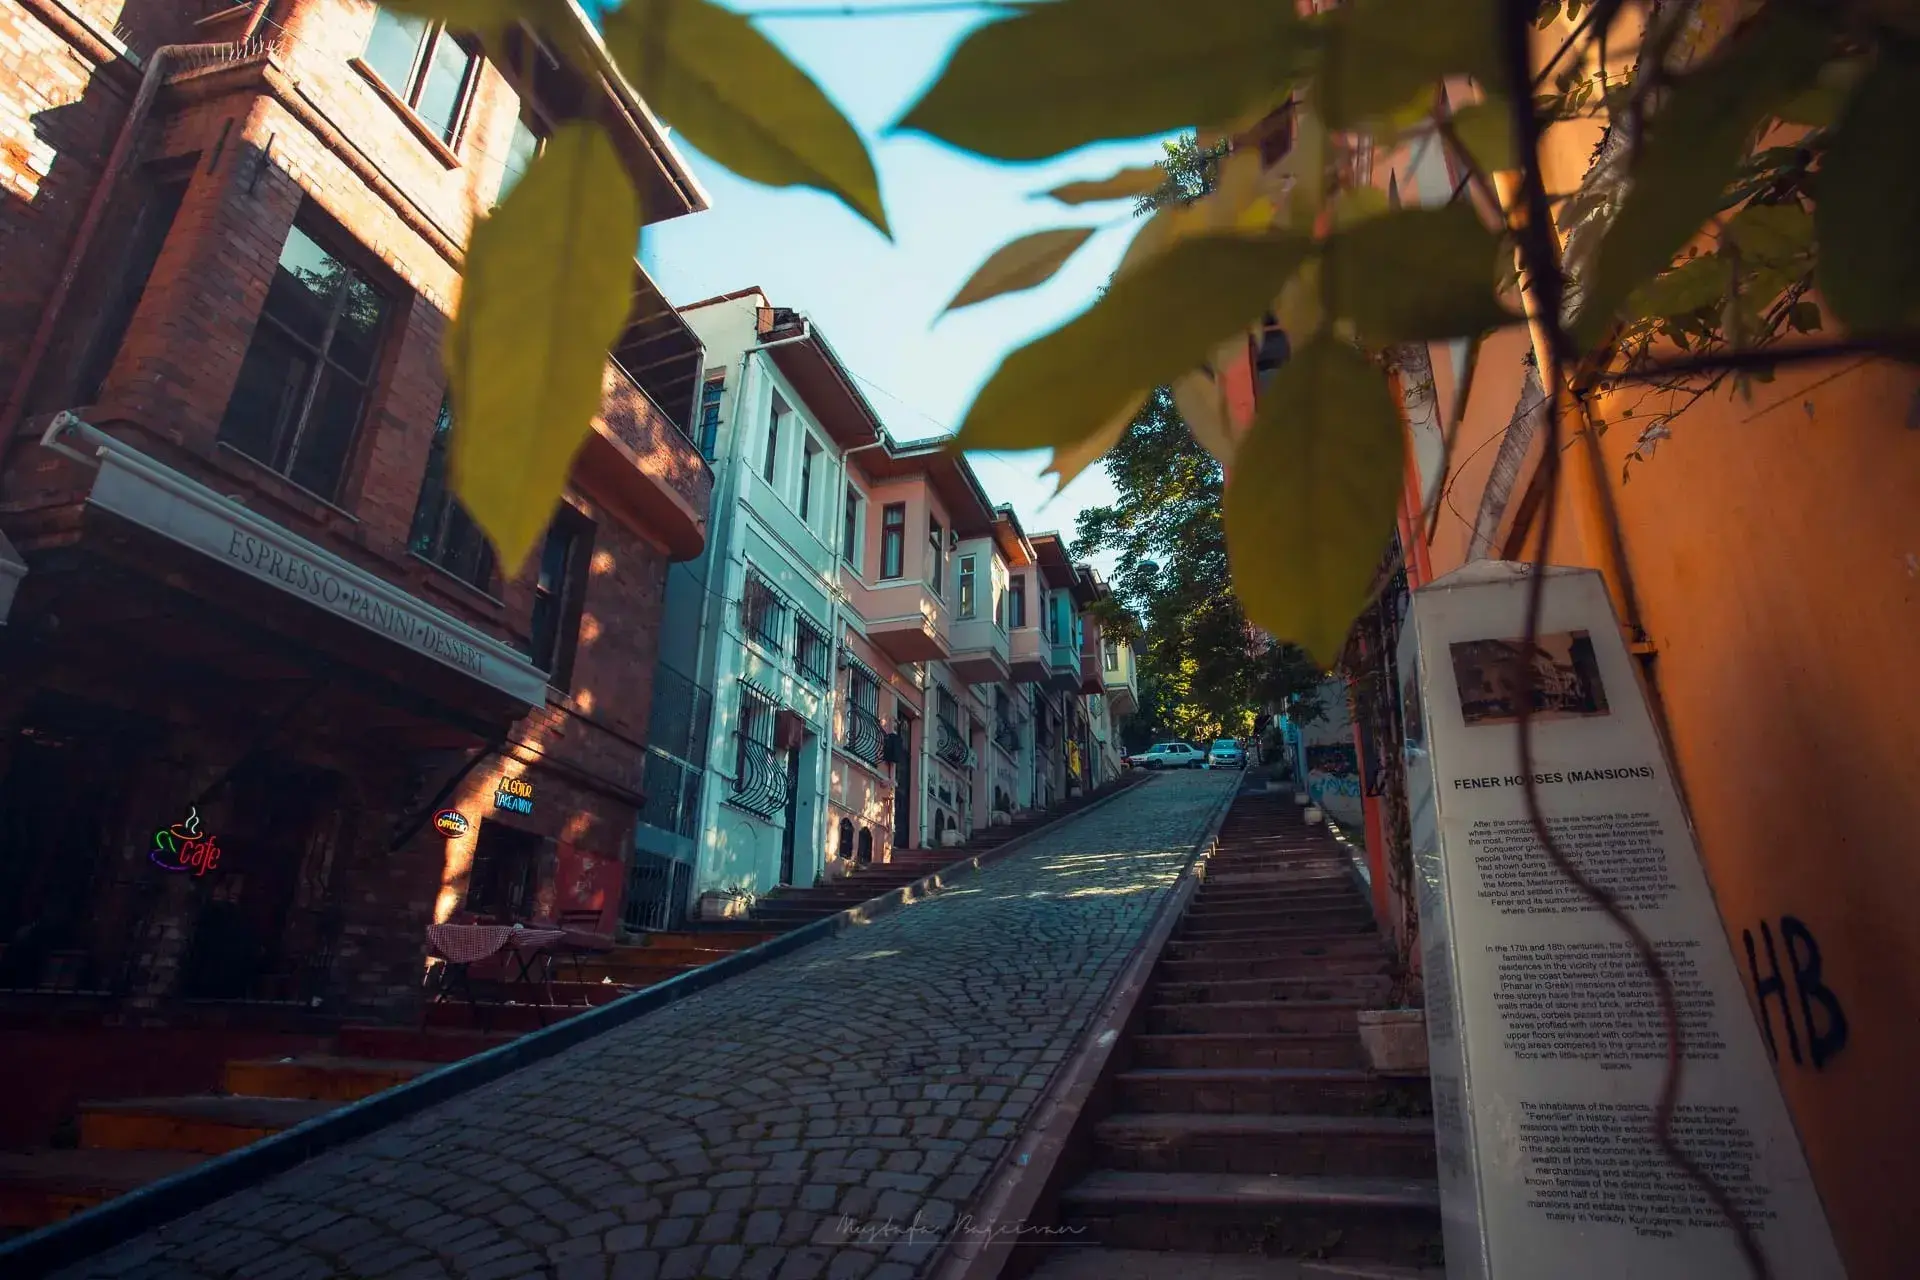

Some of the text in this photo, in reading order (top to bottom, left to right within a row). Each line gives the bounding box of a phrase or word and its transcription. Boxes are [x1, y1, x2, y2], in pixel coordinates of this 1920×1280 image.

[229, 530, 486, 674] ESPRESSO PANINI DESSERT
[1454, 776, 1501, 790] FENER
[1568, 766, 1655, 784] (MANSIONS)
[1484, 845, 1523, 854] Conqueror
[1502, 854, 1522, 862] living
[1494, 862, 1520, 870] shown
[1496, 944, 1508, 952] the
[1510, 944, 1527, 952] 17th
[1530, 943, 1544, 951] and
[1502, 952, 1534, 961] families
[1536, 952, 1552, 960] built
[1569, 962, 1596, 971] vicinity
[1500, 972, 1522, 982] along
[1524, 972, 1536, 980] the
[1538, 972, 1561, 980] coast
[1494, 992, 1514, 1000] three
[1742, 915, 1848, 1070] HB
[1506, 1032, 1530, 1040] upper
[1520, 1102, 1536, 1110] The
